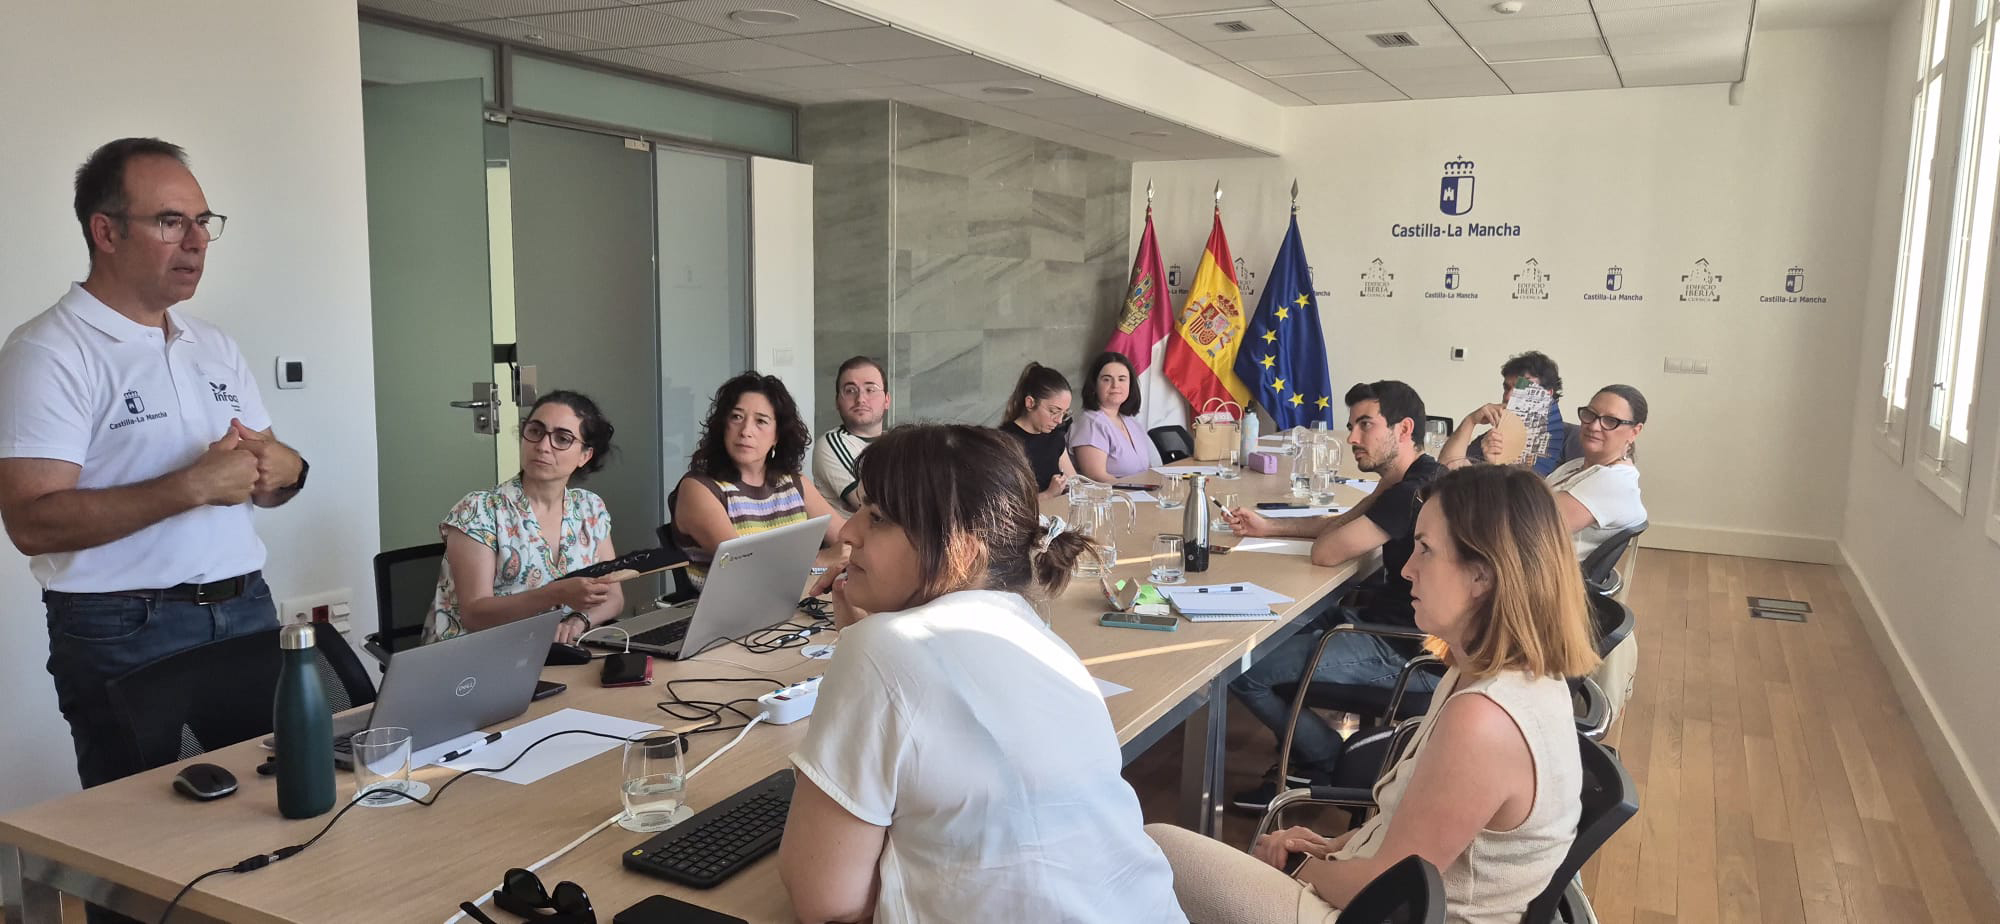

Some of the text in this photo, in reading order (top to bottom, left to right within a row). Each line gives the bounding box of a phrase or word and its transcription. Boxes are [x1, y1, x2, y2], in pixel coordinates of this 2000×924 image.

[1391, 222, 1521, 238] Castilla-La Mancha
[1424, 291, 1455, 299] Castilla-La
[1583, 293, 1617, 301] Castilla-La
[1759, 295, 1827, 304] Castilla-La Mancha
[109, 411, 168, 430] Castilla-La Mancha
